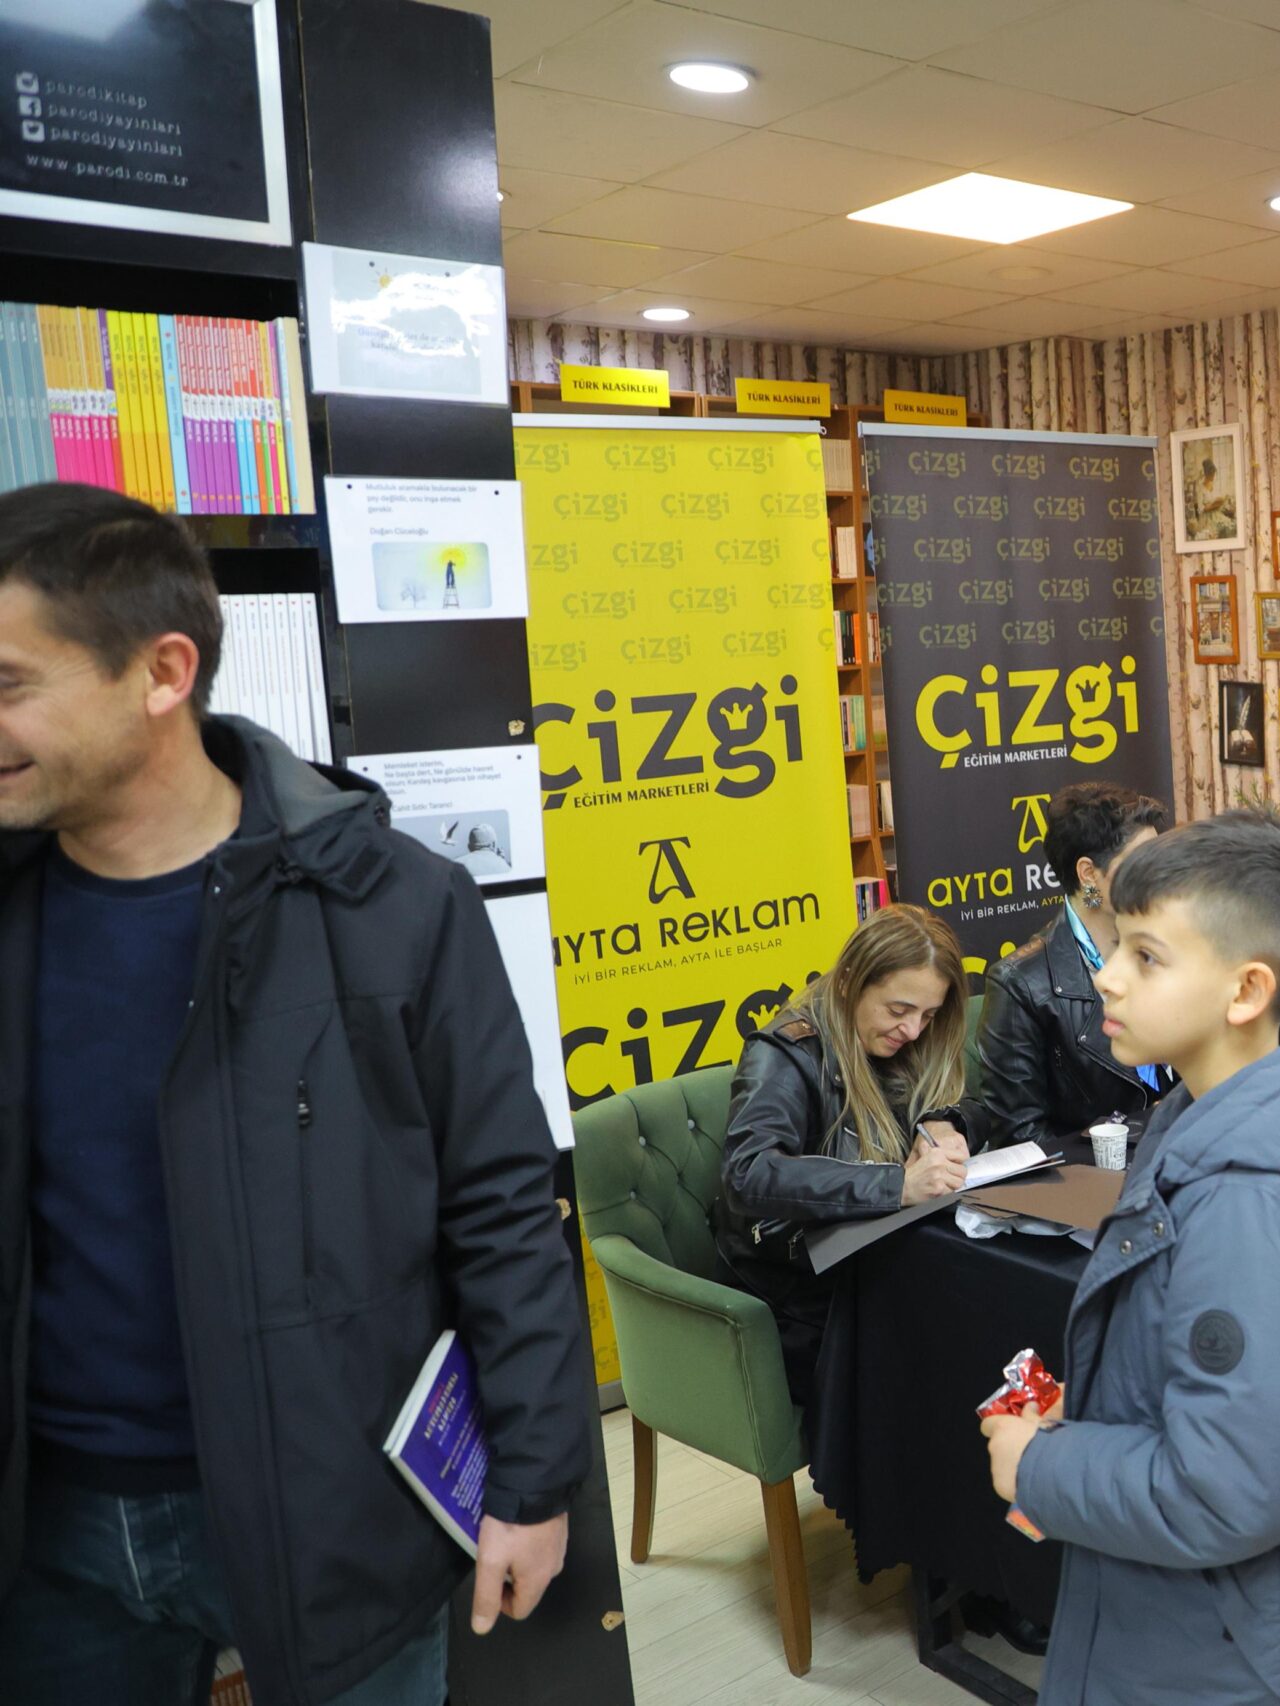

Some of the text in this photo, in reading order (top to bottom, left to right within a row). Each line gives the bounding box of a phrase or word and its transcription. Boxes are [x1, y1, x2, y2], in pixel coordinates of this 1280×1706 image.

[573, 380, 658, 393] TÜRK KLASİKLERİ
[748, 392, 820, 405] TÜRK KLASİKLERİ
[894, 404, 914, 413] TÜRK
[964, 744, 1068, 768] EĞİTİM MARKETLERİ
[574, 781, 710, 808] EĞİTİM MARKETLERİ
[961, 909, 973, 921] İYİ
[977, 905, 994, 918] BİR
[997, 900, 1039, 914] REKLAM,
[574, 938, 782, 985] İYİ BİR REKLAM, AYTA İLE BAŞLAR
